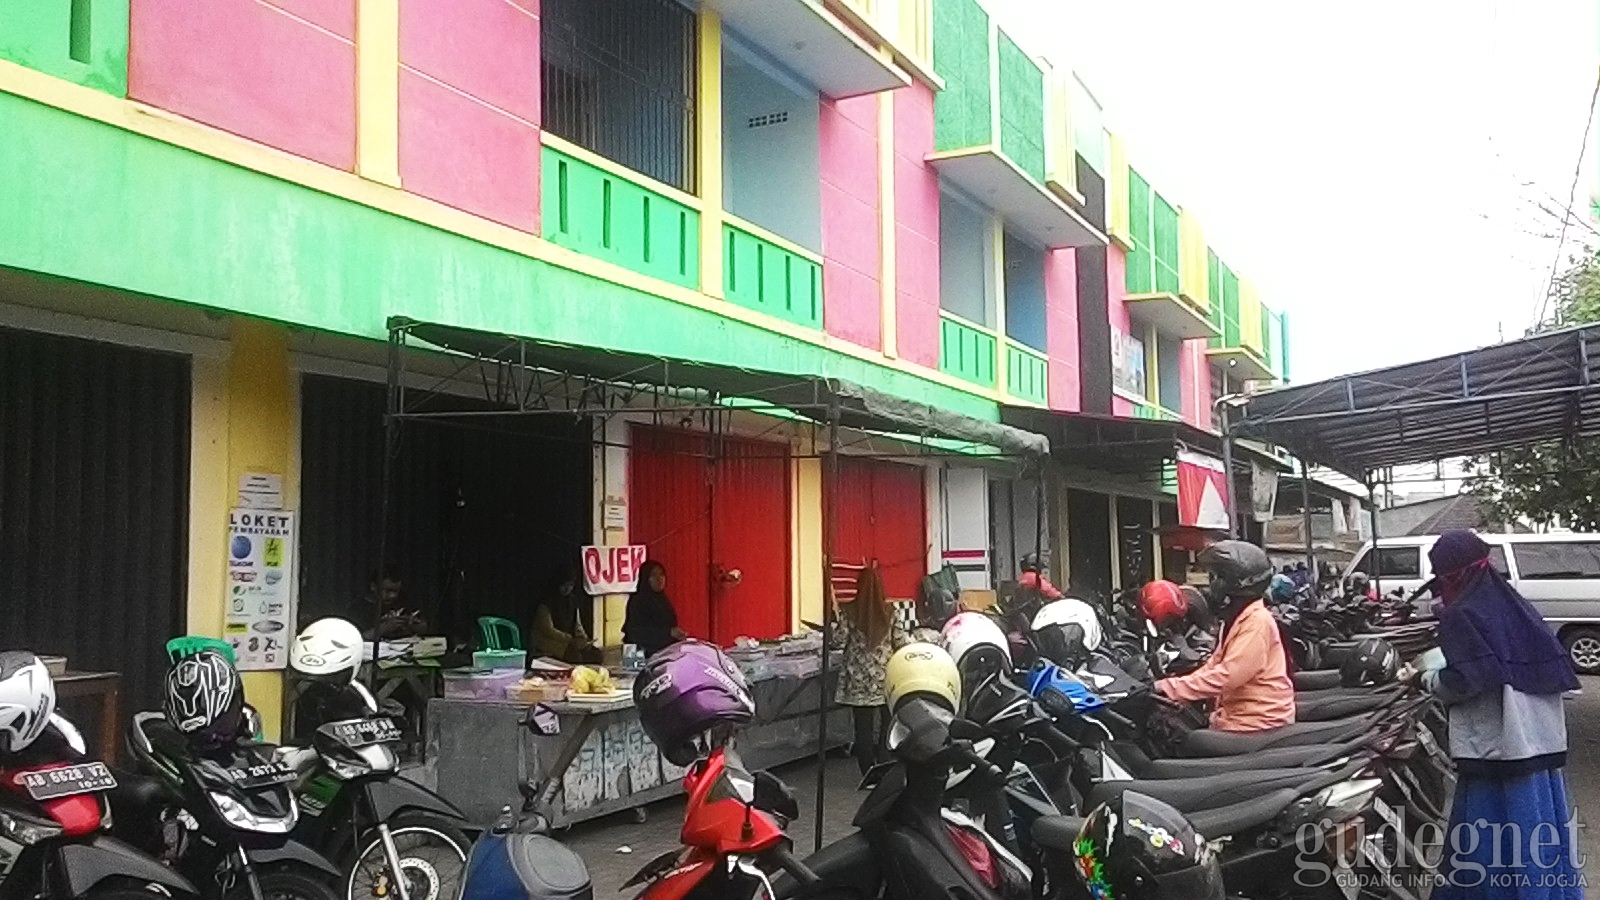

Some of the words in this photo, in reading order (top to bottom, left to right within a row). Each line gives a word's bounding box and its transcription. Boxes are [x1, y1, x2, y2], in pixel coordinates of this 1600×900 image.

[230, 513, 289, 528] LOKET
[584, 547, 645, 584] OJEK
[26, 774, 47, 788] AB
